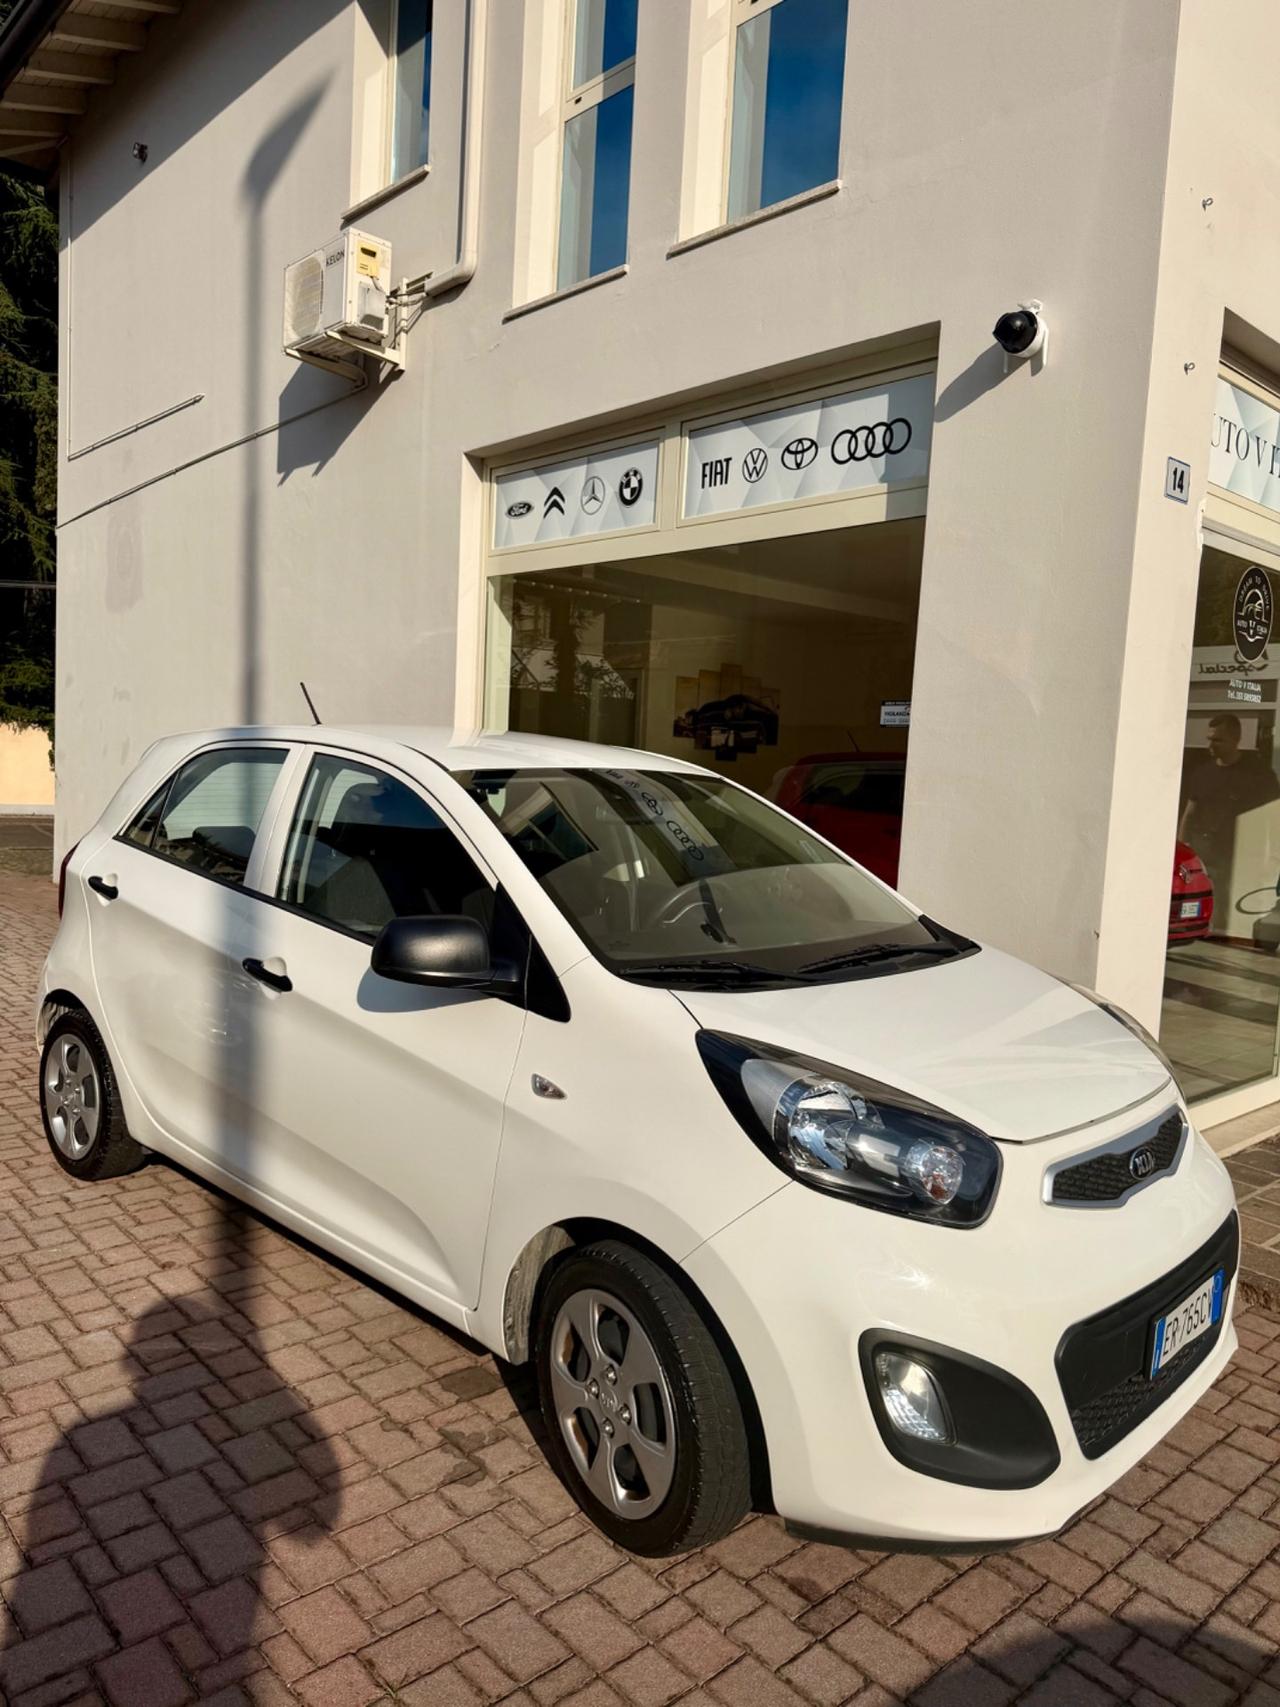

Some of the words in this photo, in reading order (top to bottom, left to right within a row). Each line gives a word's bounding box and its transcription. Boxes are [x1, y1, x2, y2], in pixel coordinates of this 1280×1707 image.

[326, 249, 345, 267] KELON
[1255, 435, 1268, 468] V
[701, 457, 733, 489] FIAT
[1173, 467, 1185, 493] 14
[1163, 1317, 1179, 1356] ER
